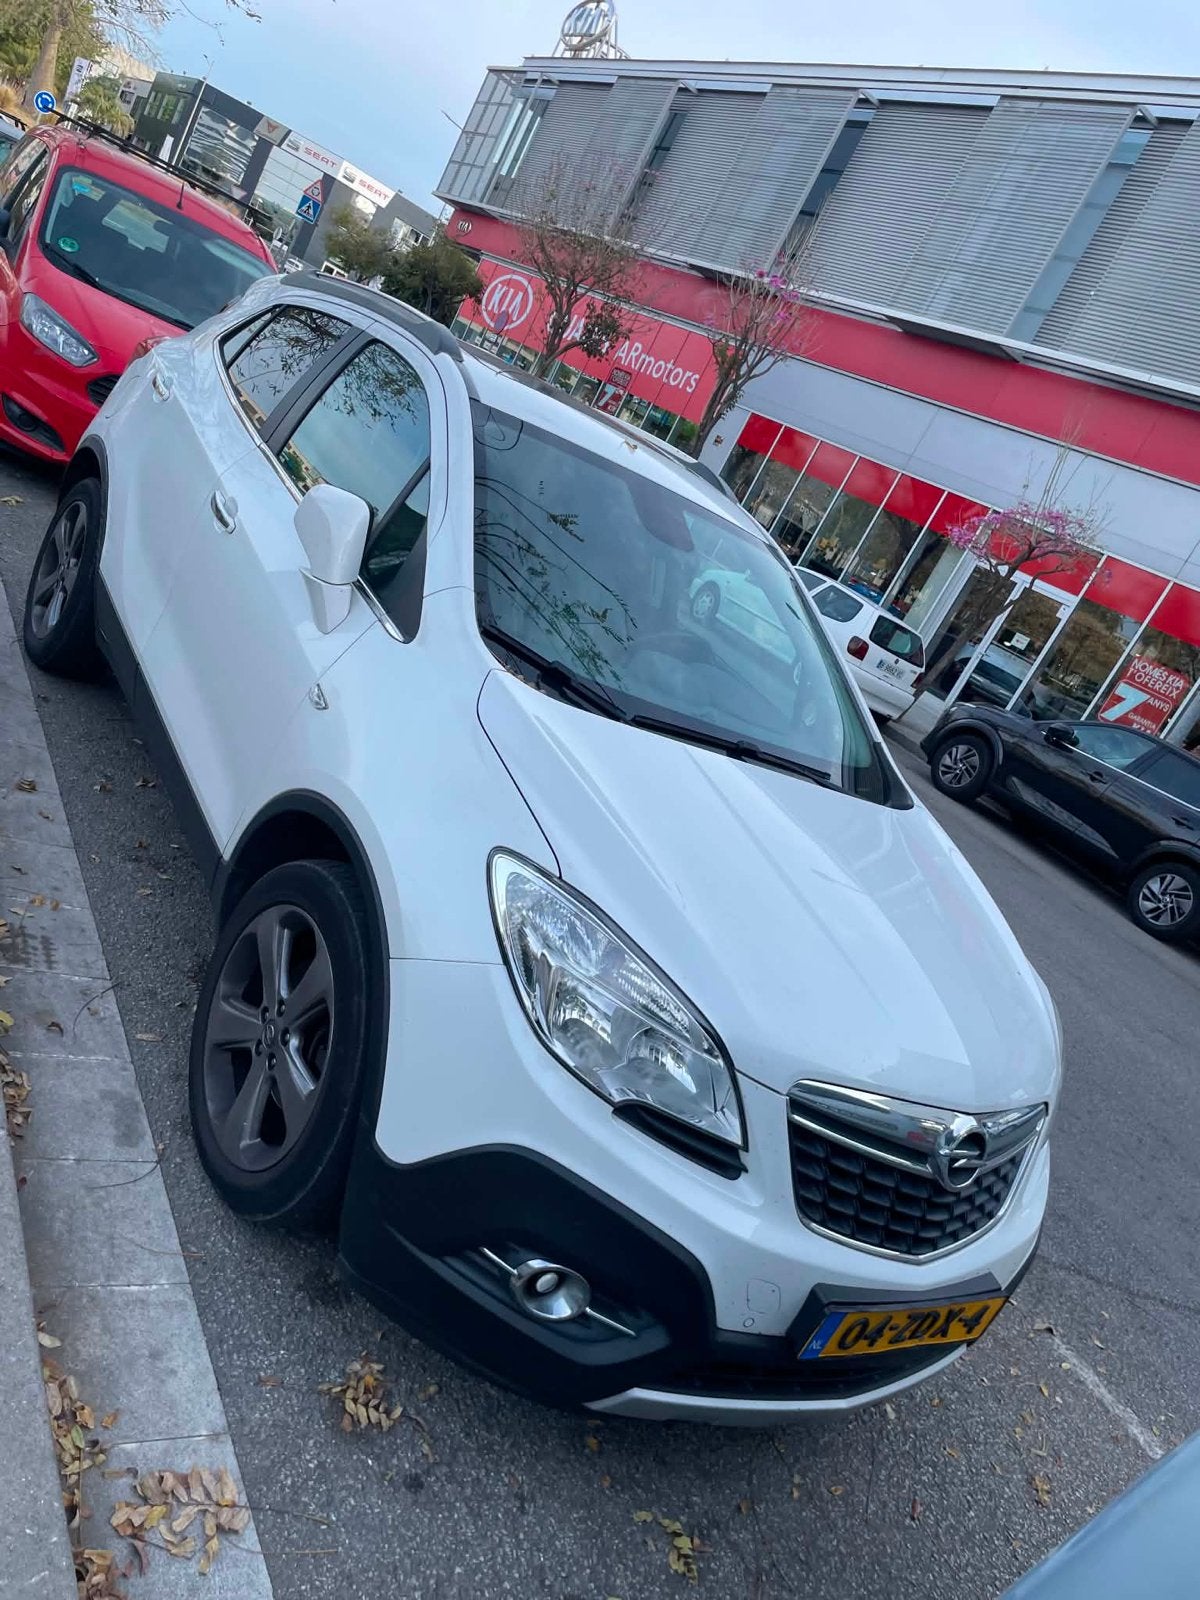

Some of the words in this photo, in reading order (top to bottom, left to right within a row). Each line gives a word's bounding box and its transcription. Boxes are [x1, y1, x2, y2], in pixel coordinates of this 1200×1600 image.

[303, 147, 337, 168] SEAT
[358, 179, 390, 201] SEAT
[487, 283, 524, 321] KIA
[613, 339, 701, 393] ARmotors
[1126, 667, 1180, 699] T'OFEREIX
[1130, 658, 1168, 682] NOMÉS
[1165, 674, 1184, 691] KIA
[1100, 681, 1151, 721] 7
[1146, 697, 1170, 713] ANYS
[838, 1304, 990, 1350] 04-ZDX-4
[810, 1339, 822, 1350] NL
